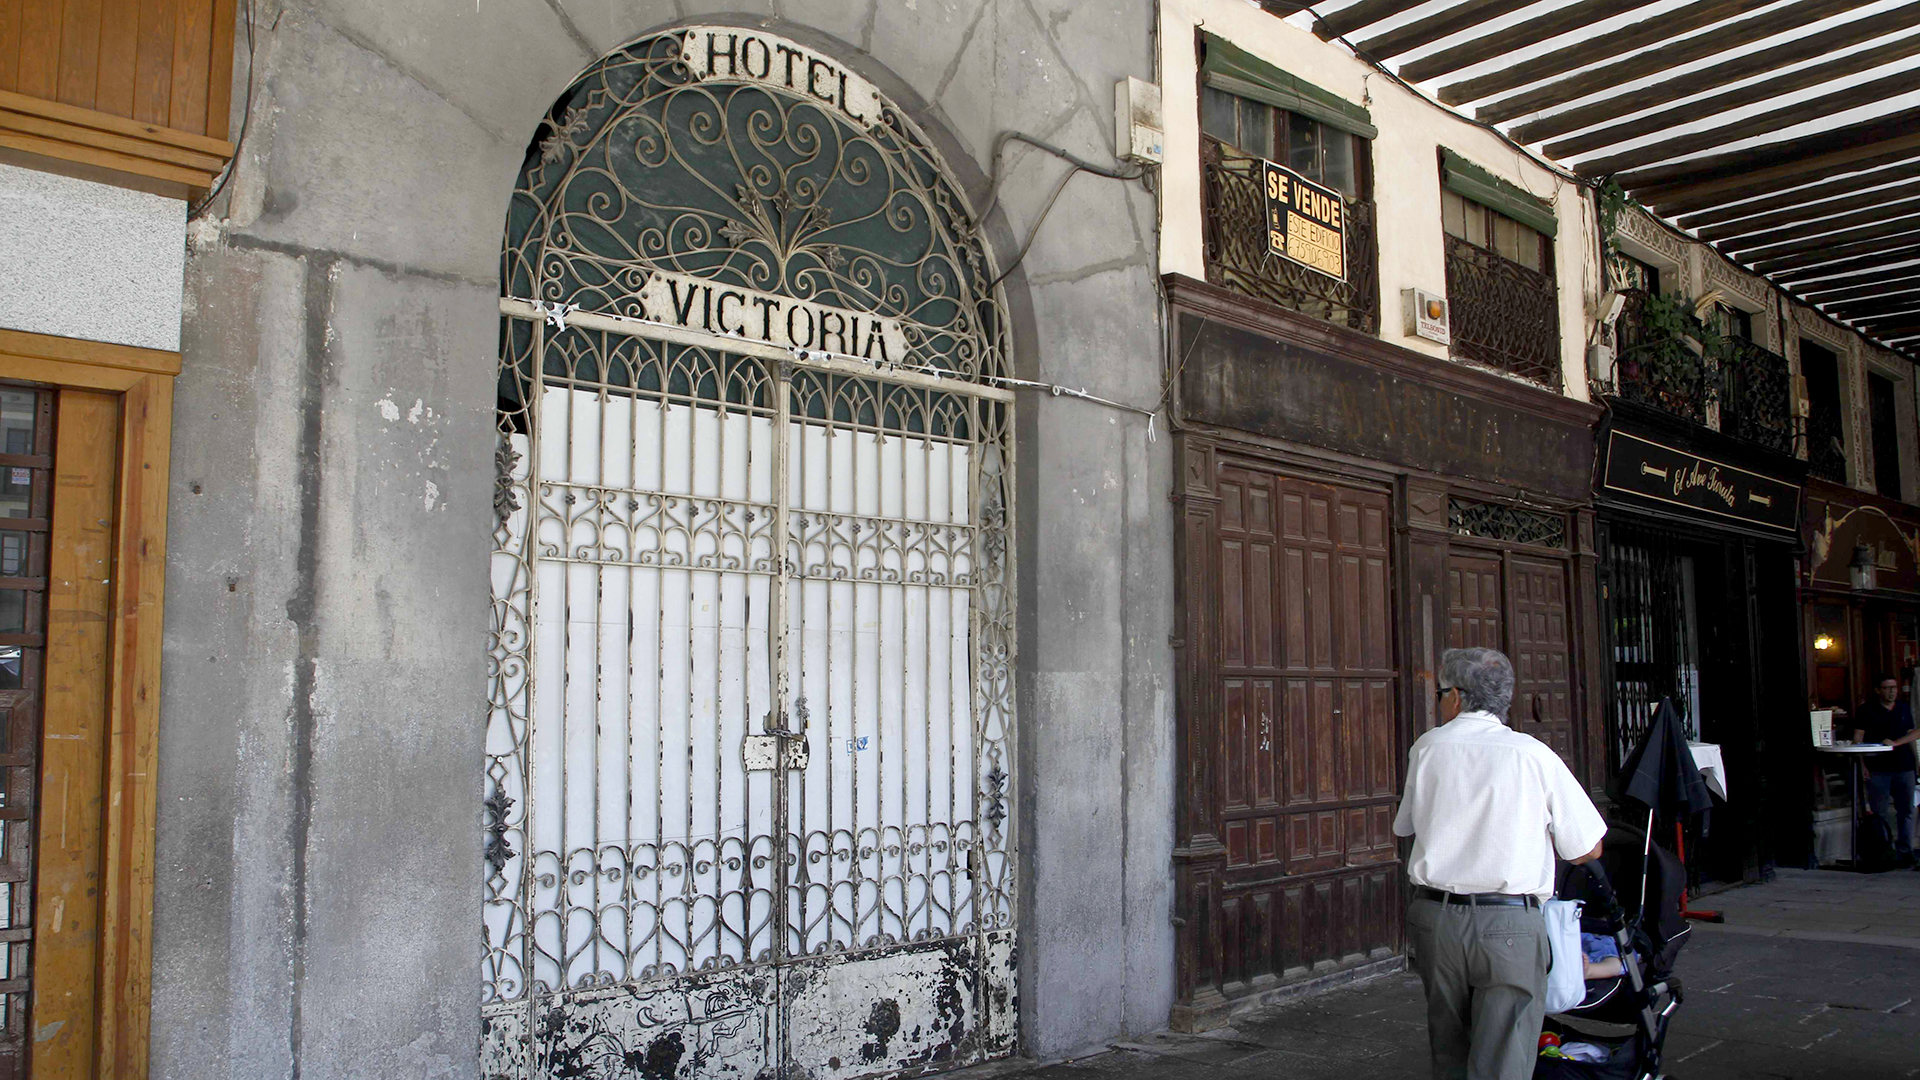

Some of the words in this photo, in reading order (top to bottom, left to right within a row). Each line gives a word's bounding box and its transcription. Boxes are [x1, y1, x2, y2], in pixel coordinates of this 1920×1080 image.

[706, 32, 863, 123] HOTEL
[1267, 170, 1289, 204] SE
[1293, 180, 1341, 228] VENDE
[667, 279, 889, 362] VICTORIA
[1673, 467, 1688, 496] El
[1686, 459, 1708, 488] Ave
